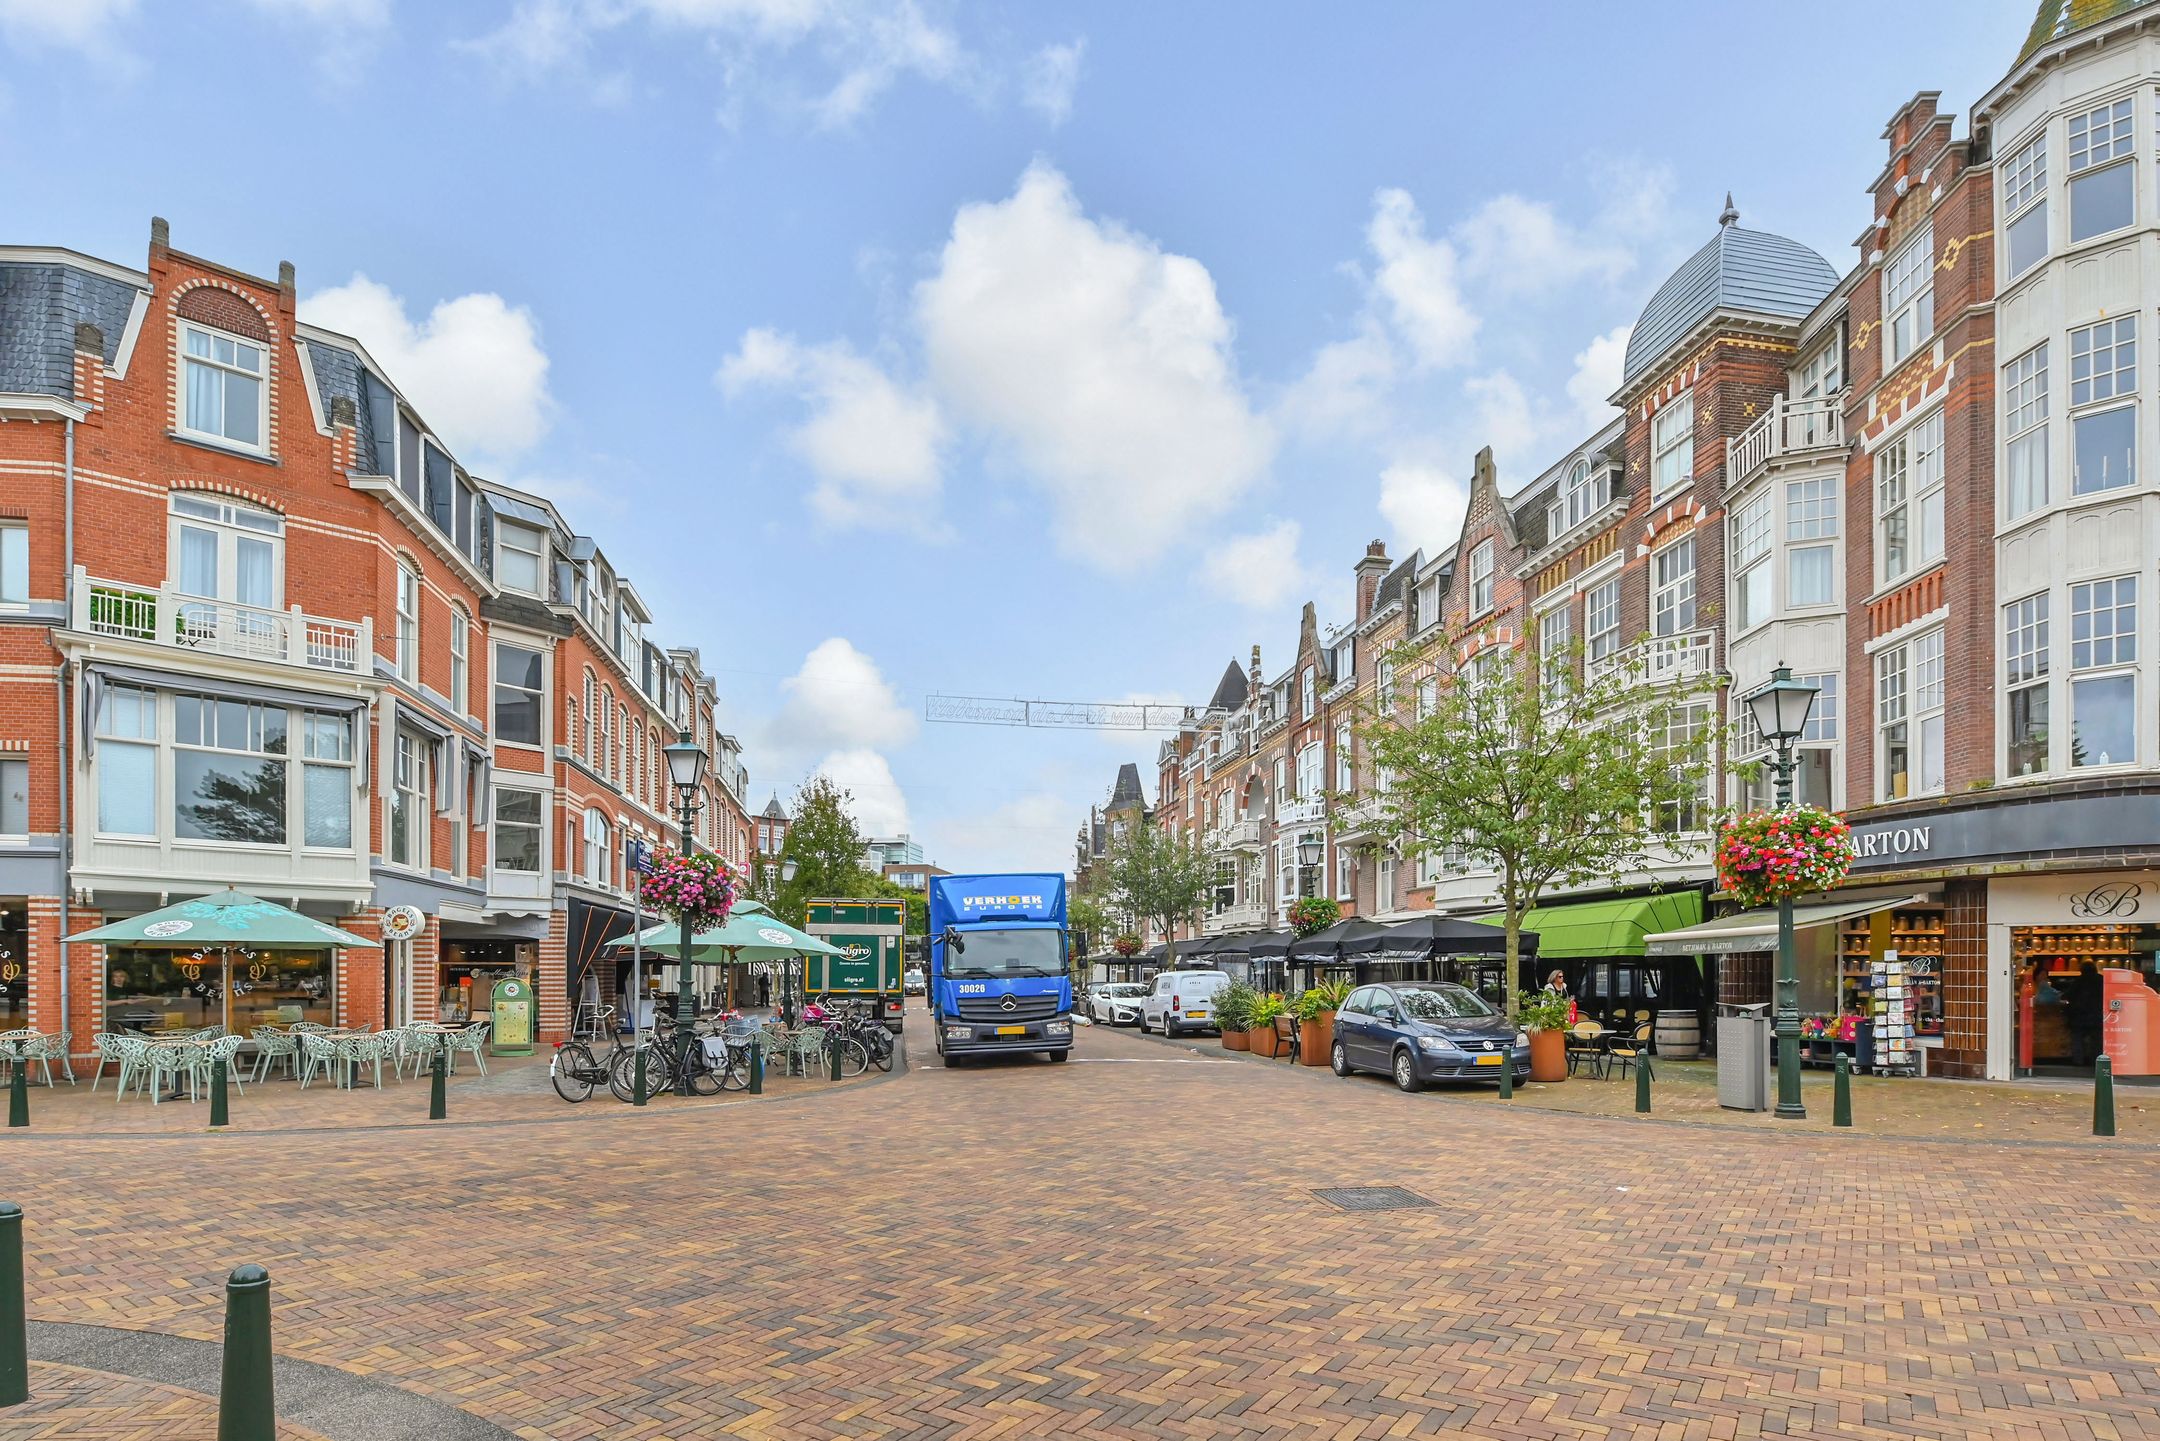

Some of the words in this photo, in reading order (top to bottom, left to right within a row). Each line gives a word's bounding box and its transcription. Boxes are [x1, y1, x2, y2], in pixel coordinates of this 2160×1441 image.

[927, 698, 1000, 720] Welkom
[1851, 826, 1930, 858] ARTON
[962, 895, 1042, 906] VERHOEK
[387, 907, 414, 919] BAGELS
[389, 928, 412, 938] BEANS
[192, 946, 257, 961] BALS
[840, 945, 870, 957] Sligro
[959, 984, 985, 993] 30026
